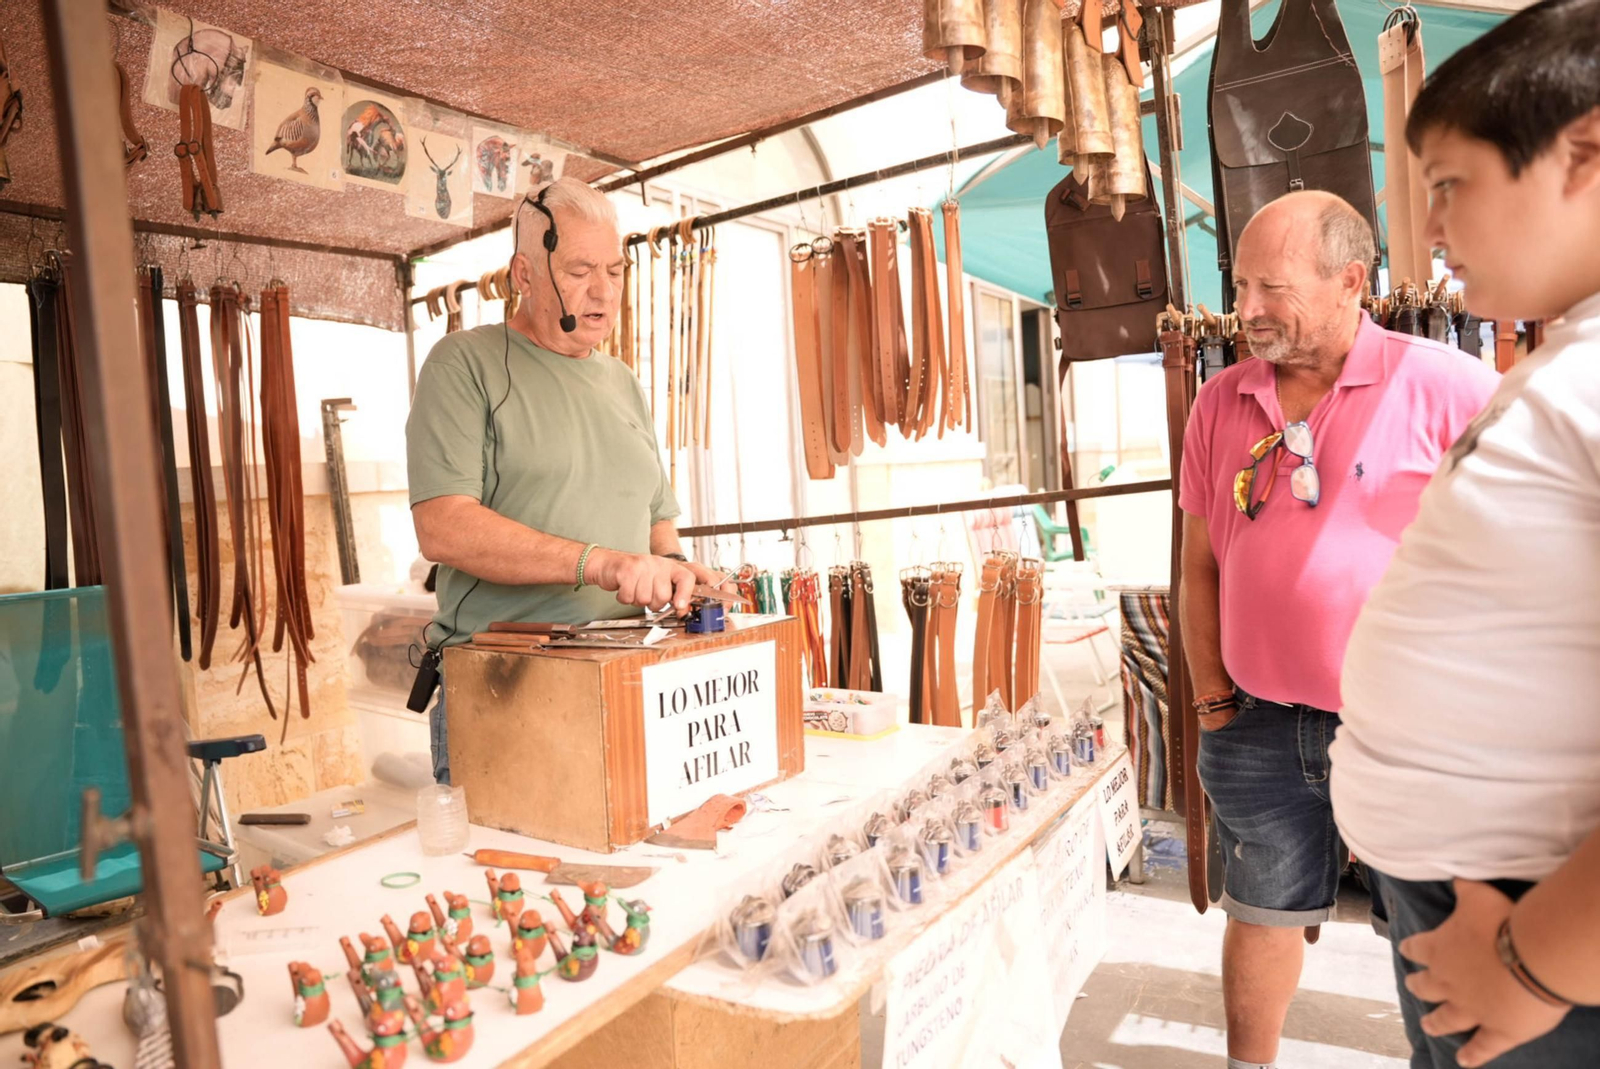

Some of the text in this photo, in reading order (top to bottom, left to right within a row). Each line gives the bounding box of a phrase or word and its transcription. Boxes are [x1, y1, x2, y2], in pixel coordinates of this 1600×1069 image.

[658, 669, 760, 719] LO MEJOR
[687, 709, 741, 748] PARA
[679, 740, 752, 789] AFILAR
[1102, 785, 1112, 804] LO
[1113, 799, 1129, 827] PARA
[1116, 823, 1135, 857] AFILAR
